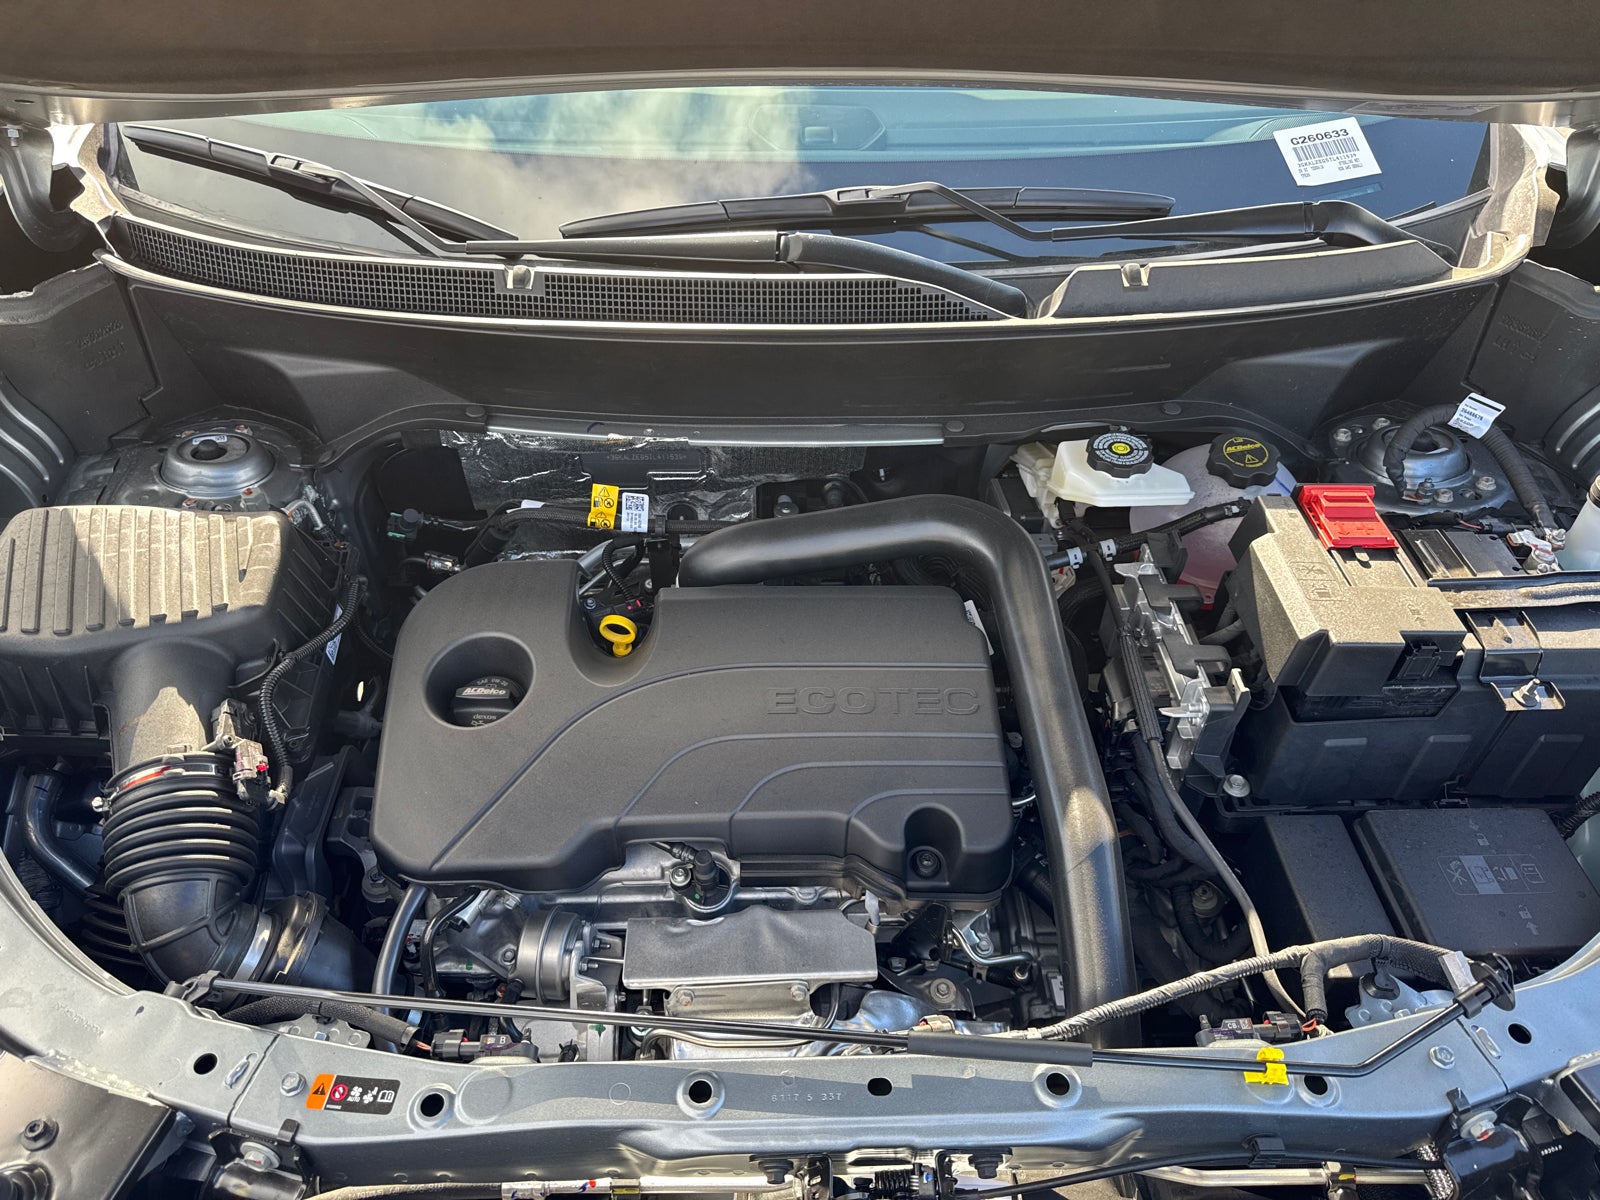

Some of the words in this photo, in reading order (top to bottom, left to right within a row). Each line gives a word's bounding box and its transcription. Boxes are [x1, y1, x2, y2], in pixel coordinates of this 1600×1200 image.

[1290, 128, 1349, 146] G260633
[1225, 443, 1261, 453] ACDelco
[462, 687, 506, 696] ACDelco
[767, 686, 980, 716] ECOTEC
